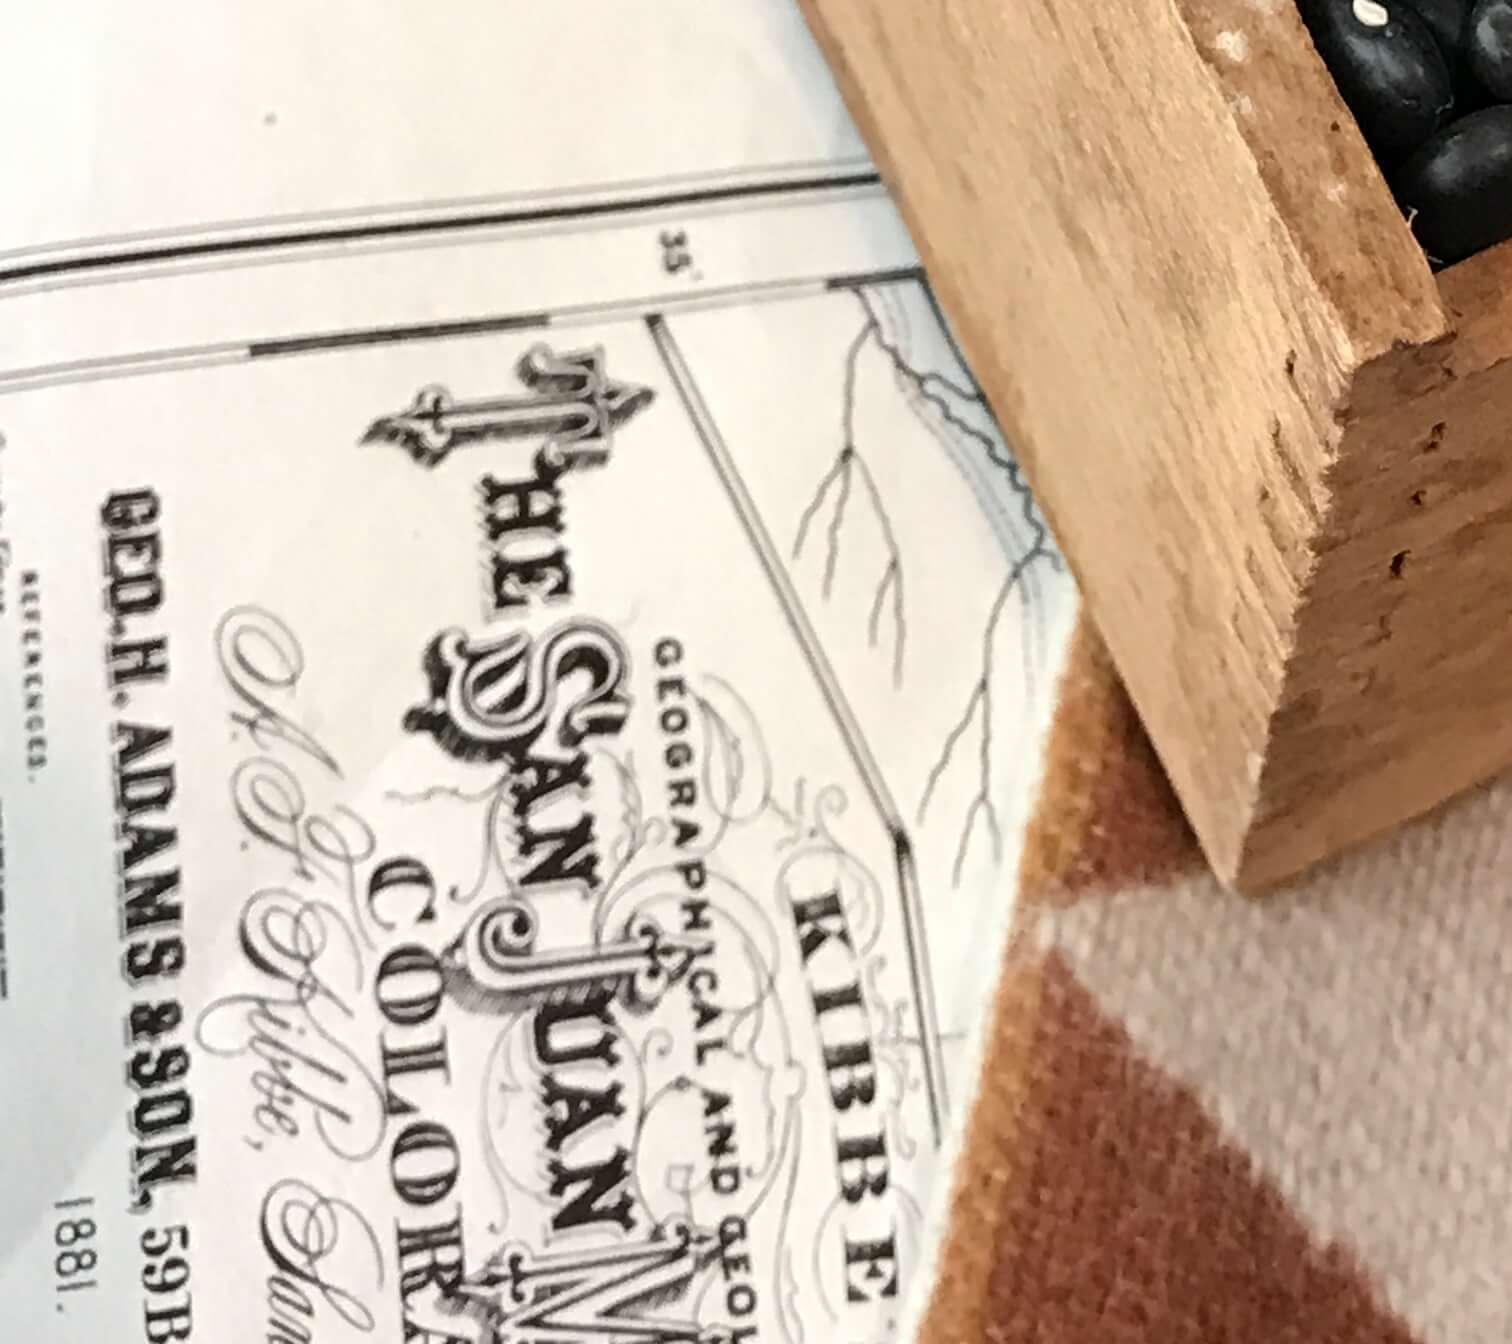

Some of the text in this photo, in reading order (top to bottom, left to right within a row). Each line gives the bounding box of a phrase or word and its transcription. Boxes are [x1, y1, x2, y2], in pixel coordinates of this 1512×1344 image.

[357, 342, 657, 618] THE
[108, 720, 188, 987] ADAMS
[403, 614, 634, 898] SAN
[194, 887, 388, 1162] Kibbe,
[653, 637, 728, 1065] GEOGRAPHICAL
[702, 1087, 740, 1195] AND
[442, 896, 697, 1234] JUAN
[54, 1196, 98, 1314] 1881.
